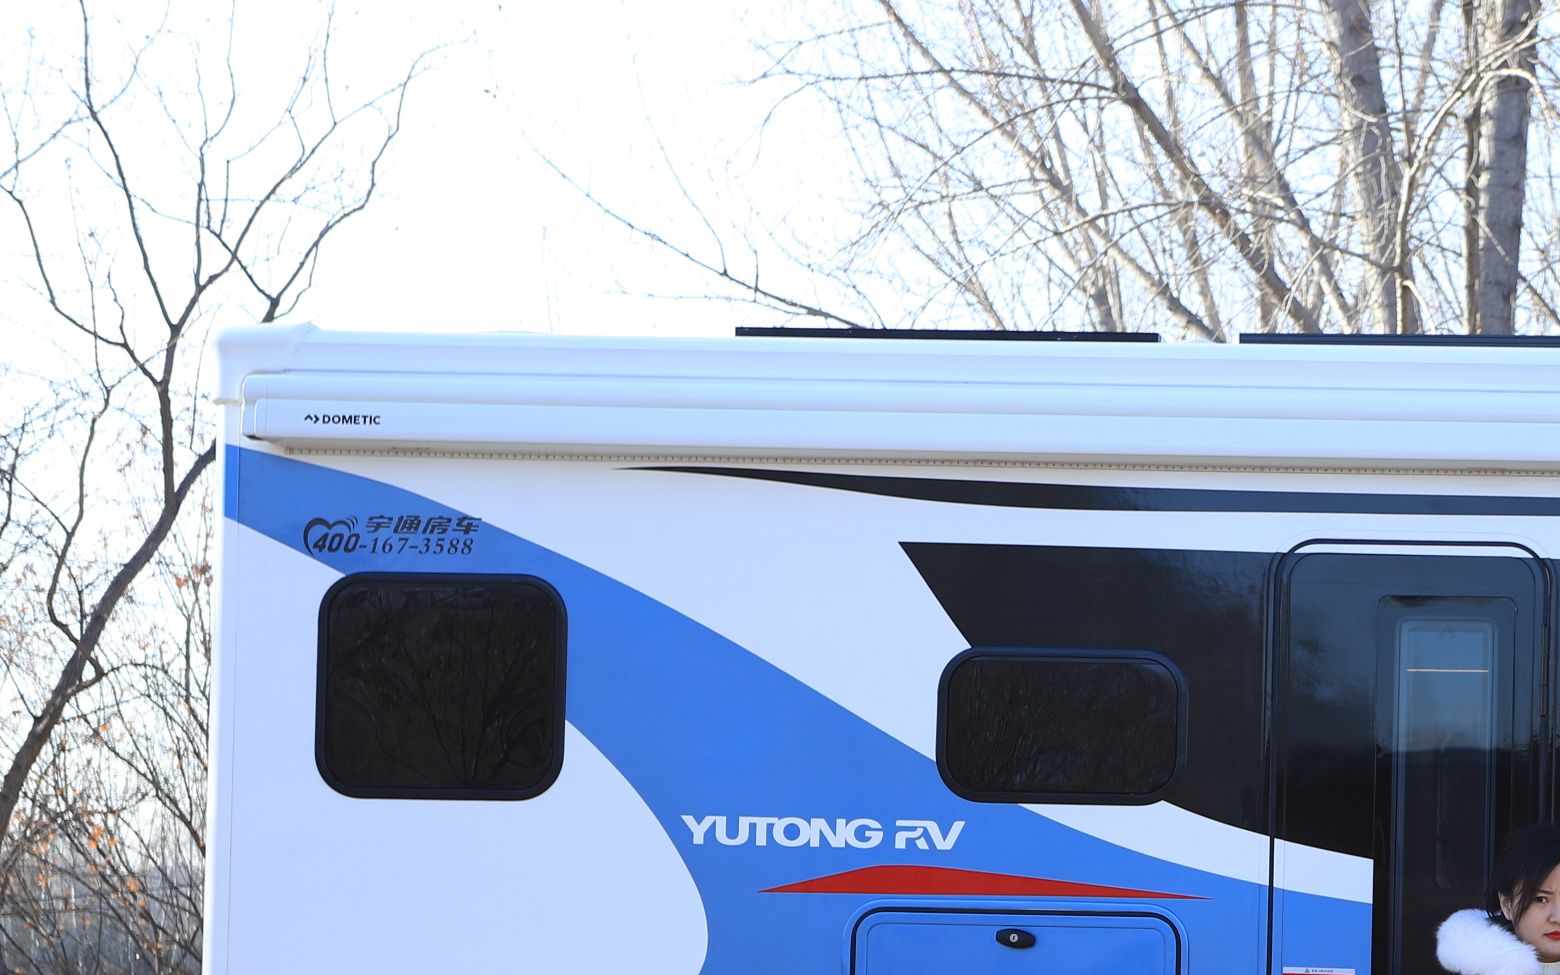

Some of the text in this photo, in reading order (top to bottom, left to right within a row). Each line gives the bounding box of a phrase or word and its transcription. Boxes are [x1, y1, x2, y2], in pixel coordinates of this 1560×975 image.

[322, 414, 381, 426] DOMETIC
[365, 515, 482, 535] 宇通房车
[313, 532, 474, 556] 400-167-3588
[680, 815, 966, 850] YUTONG RV
